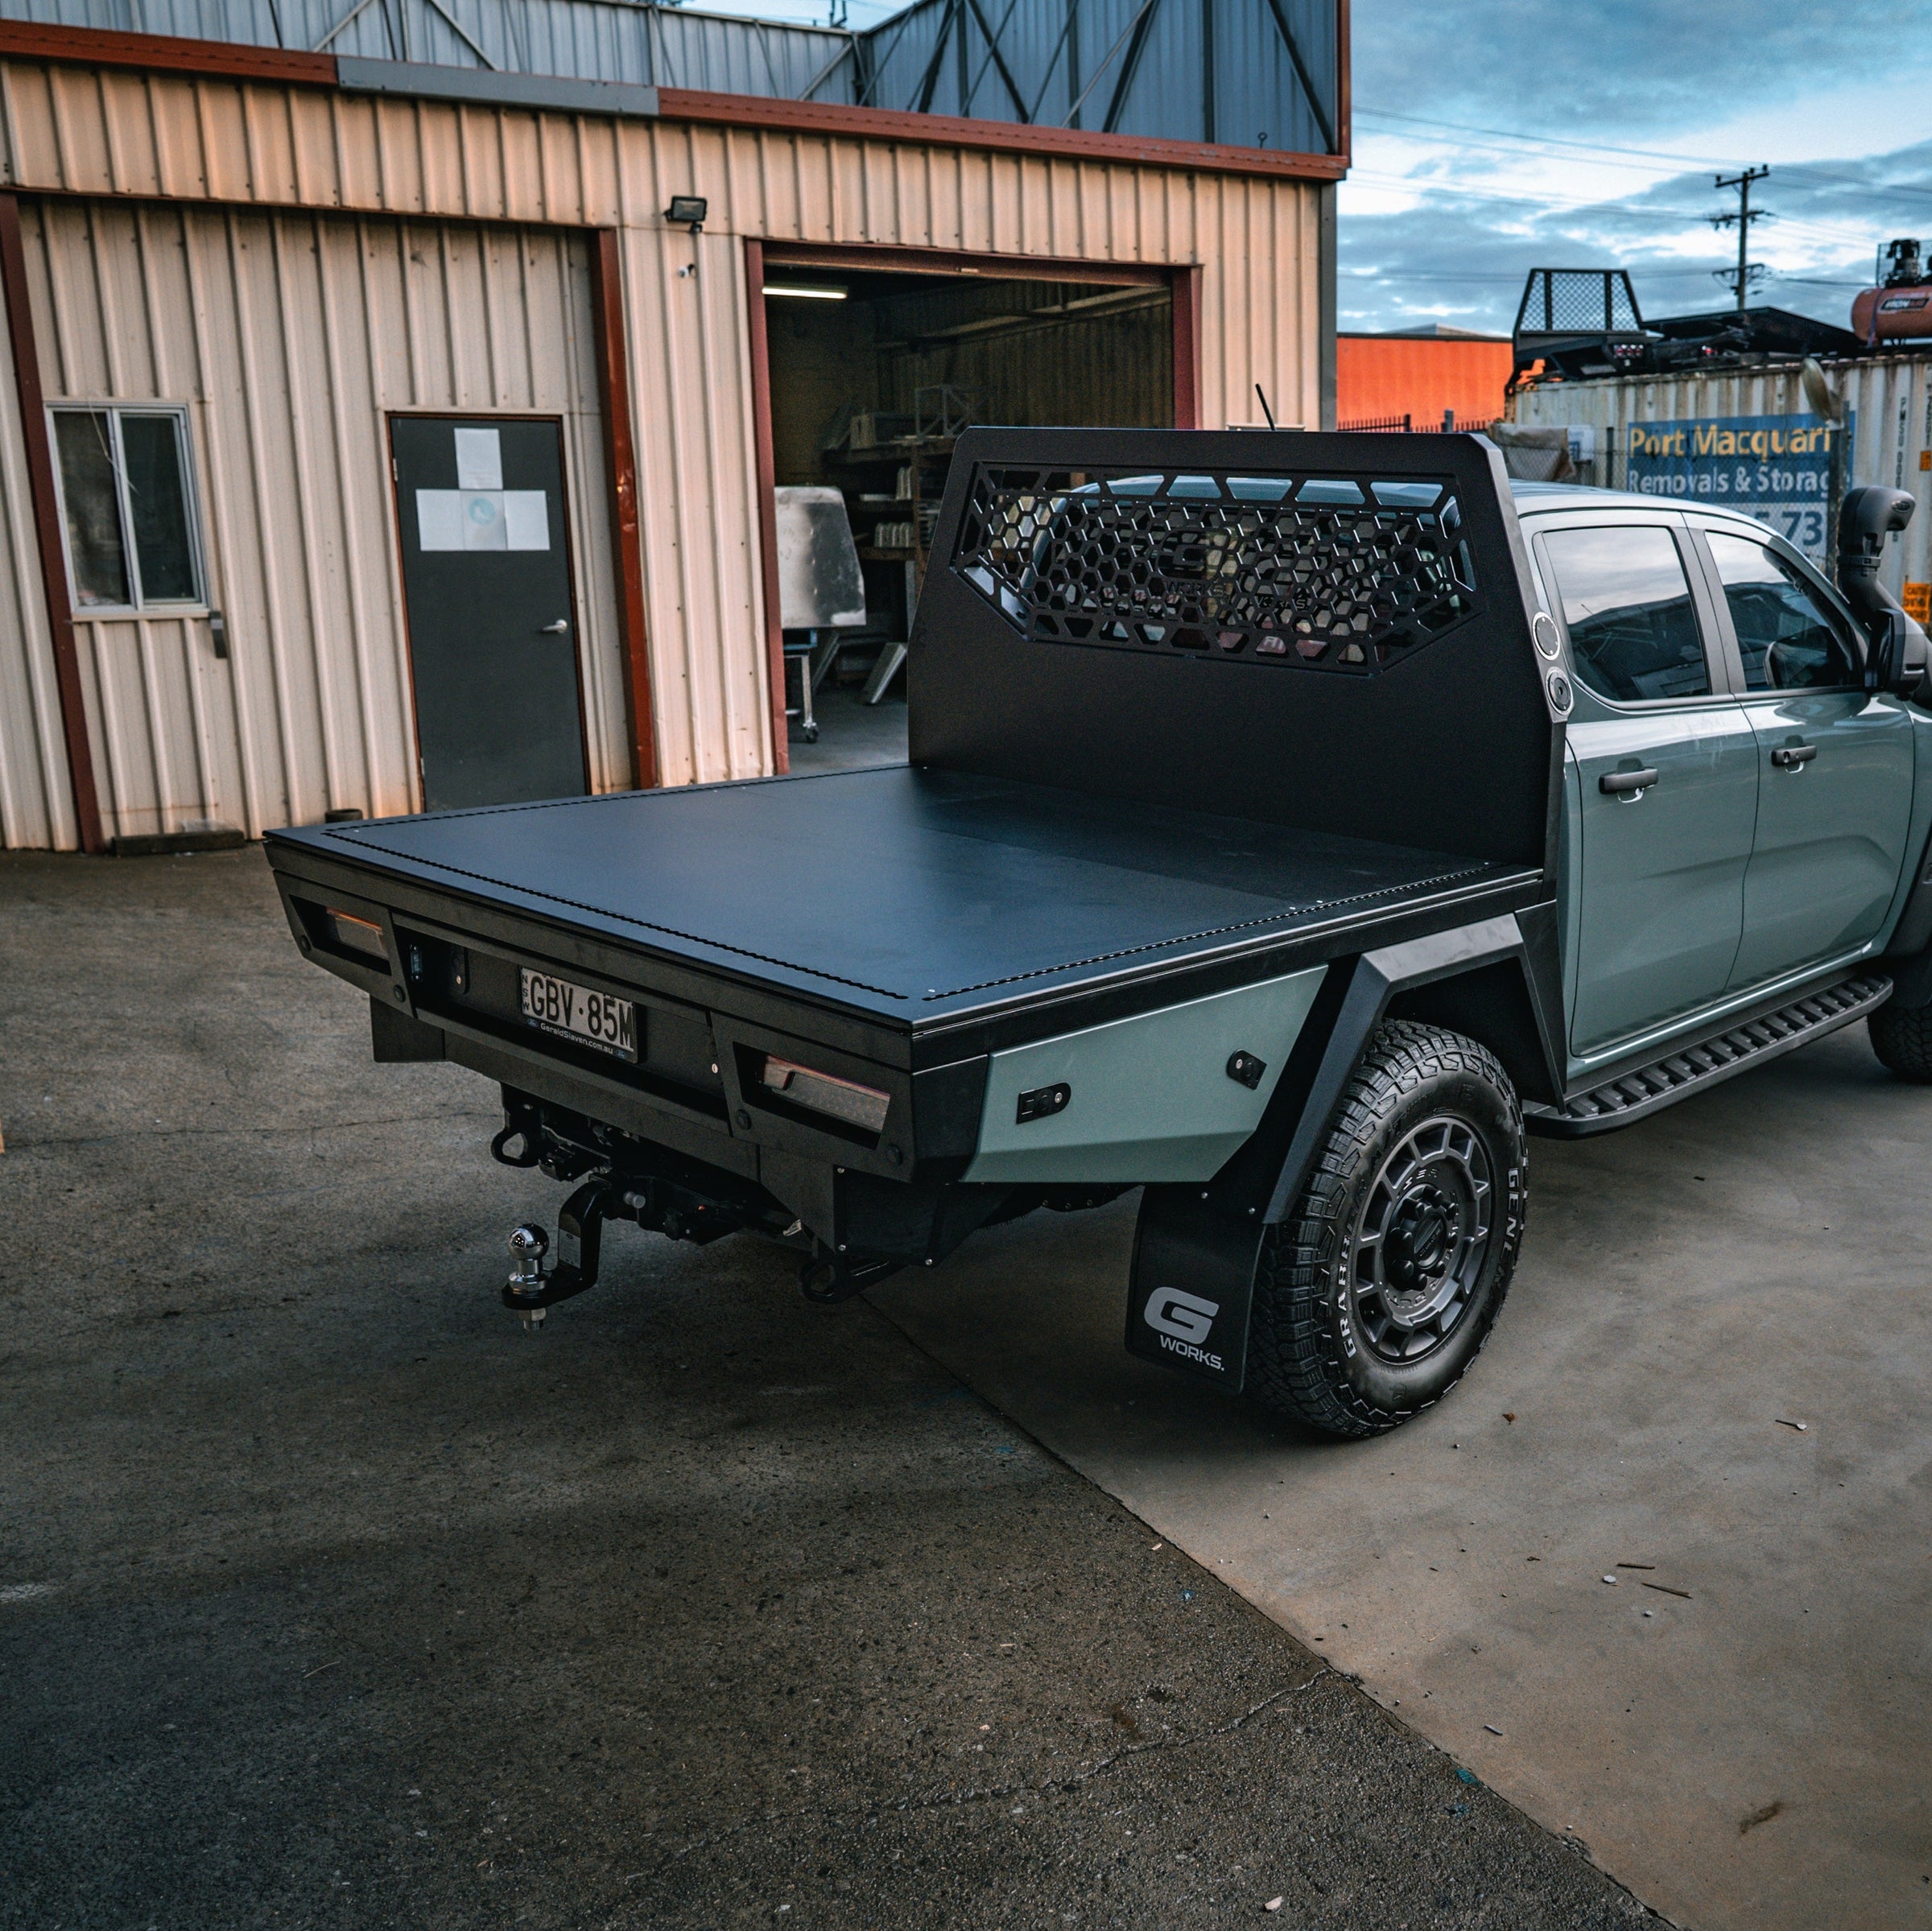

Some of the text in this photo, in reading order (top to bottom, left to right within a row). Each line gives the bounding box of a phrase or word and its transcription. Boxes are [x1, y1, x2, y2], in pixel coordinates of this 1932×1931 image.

[1629, 427, 1686, 459] Port
[1693, 423, 1831, 463] Macquari
[1629, 466, 1730, 494] Removals
[1735, 466, 1752, 493] &
[540, 1021, 613, 1054] GeraldSlaven.com.au
